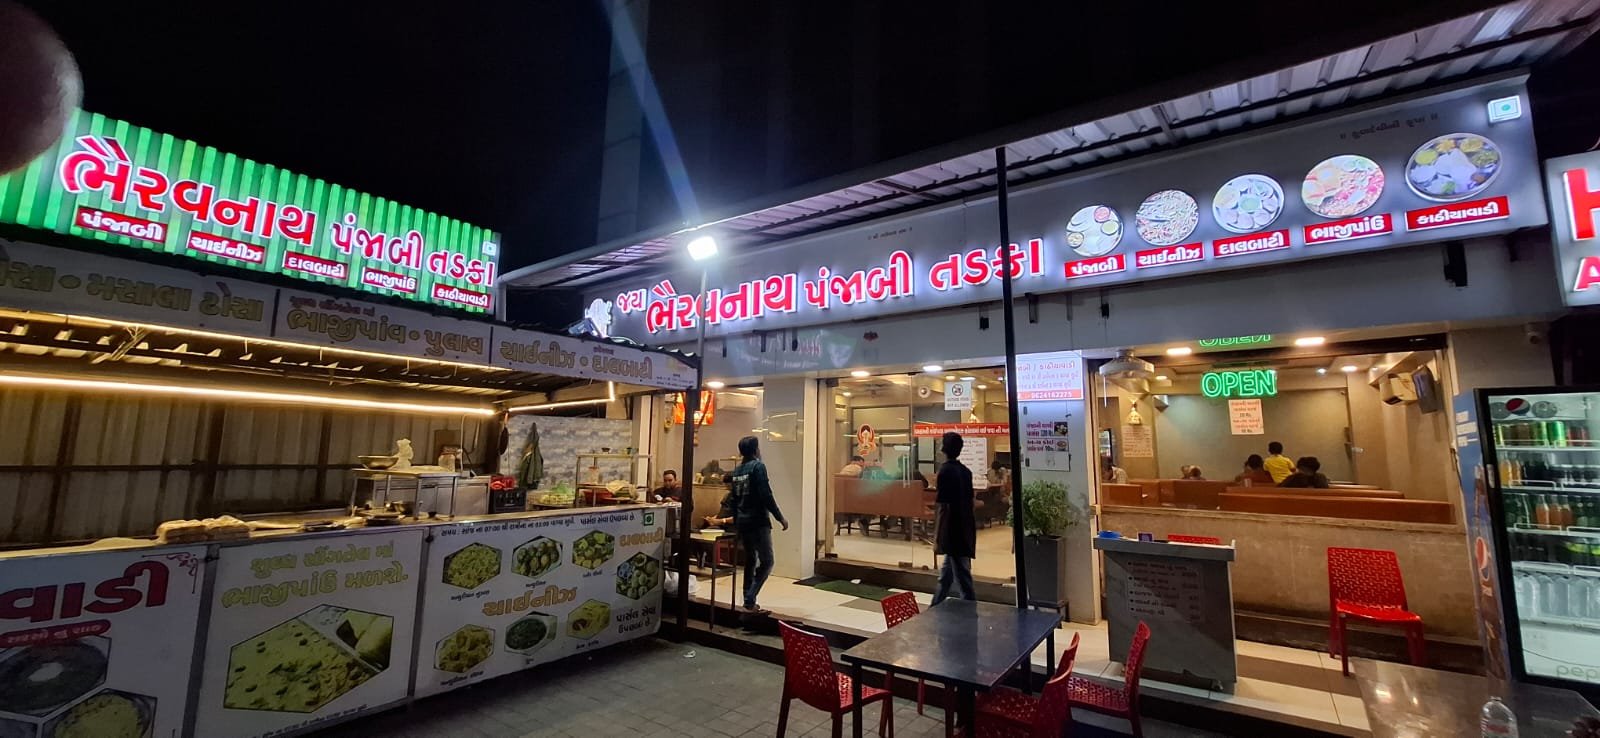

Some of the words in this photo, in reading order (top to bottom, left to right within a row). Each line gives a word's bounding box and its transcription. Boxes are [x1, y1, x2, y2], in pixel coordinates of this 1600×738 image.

[60, 134, 317, 247] ભૈરવનાથ
[331, 212, 424, 271] પંજાબી
[427, 249, 496, 287] તડકા
[1416, 201, 1500, 225] કાઠીયાવાડી
[79, 210, 164, 241] પંજાબી
[1310, 214, 1385, 240] ભાજીપાંઉ
[190, 235, 264, 262] ચાઈનીઝ
[1218, 231, 1285, 255] દાલબાટી
[287, 256, 345, 279] દાલબાટી
[1070, 257, 1119, 276] પંજાબી
[1138, 246, 1201, 267] ચાઈનીઝ
[365, 270, 416, 290] ભાજીપાંઉ
[616, 288, 647, 314] જય
[646, 272, 798, 335] ભૈરવનાથ
[804, 249, 915, 310] પંજાબી
[929, 238, 1044, 291] તડકા
[437, 286, 489, 307] કાઠીયાવાડી
[424, 329, 484, 357] પુલાવ
[500, 340, 576, 369] ચાઈનીઝ
[592, 356, 653, 380] દાલબાટી
[1201, 369, 1277, 397] OPEN
[481, 585, 579, 617] ચાઈનીઝ
